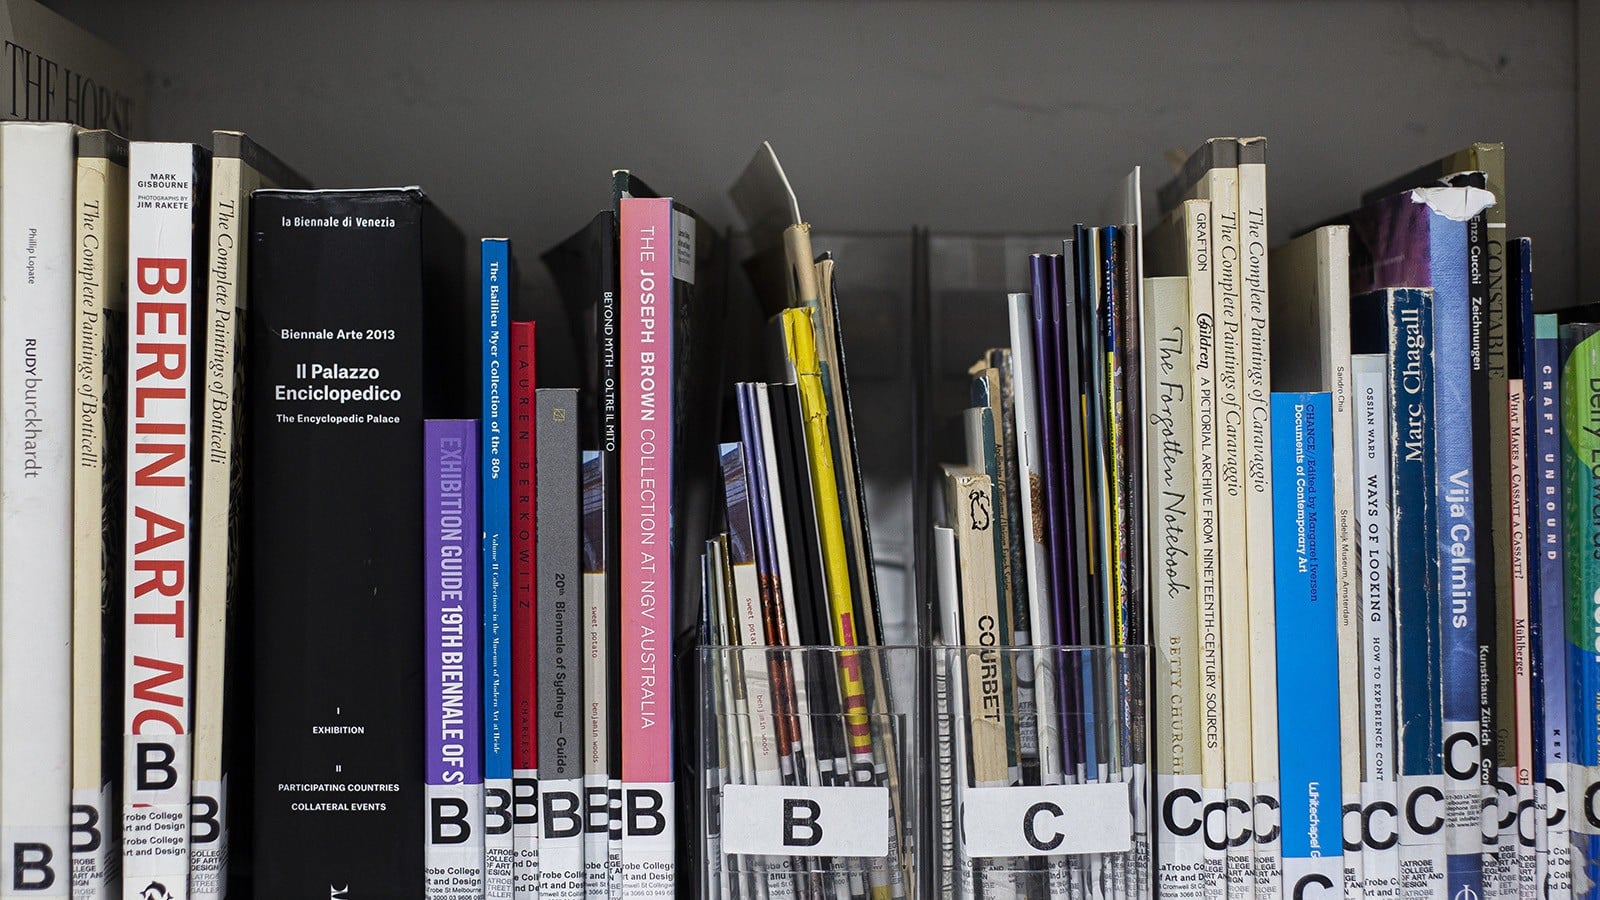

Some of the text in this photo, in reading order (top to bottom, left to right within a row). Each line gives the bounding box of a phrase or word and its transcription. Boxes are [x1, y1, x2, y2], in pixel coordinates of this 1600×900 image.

[282, 216, 394, 227] la Biennale di Venezia
[1197, 213, 1207, 271] GRAFTON
[26, 228, 36, 284] Phillip Lopate
[490, 285, 499, 326] Baillieu
[1470, 215, 1482, 370] Enzo Cucchi Zeichnungen
[1488, 240, 1504, 378] CONSTABLE
[78, 201, 99, 468] The Complete Paintings of Botticelli
[209, 200, 235, 462] The Complete Paintings of Botticelli
[281, 329, 395, 340] Biennale Arte 2013
[489, 331, 498, 356] Myer
[1197, 312, 1213, 370] Children
[1217, 212, 1241, 496] The Complete Paintings of Caravaggio
[1245, 208, 1267, 491] The Complete Paintings Caravaggio
[276, 385, 401, 403] Enciclopedico
[297, 364, 379, 379] Il Palazzo
[491, 360, 500, 417] Collection
[604, 292, 614, 451] BEYOND MYTH OLTRE IL MITO
[1402, 308, 1424, 462] Marc Chagall
[276, 414, 400, 424] The Encyclopedic Palace
[491, 421, 499, 433] of
[1295, 404, 1304, 463] Documents
[133, 258, 186, 636] BERLIN ART
[491, 458, 500, 478] 80s
[1150, 327, 1190, 599] The Forgotten Notebook
[1543, 365, 1556, 559] CRAFT UNBOUND
[520, 344, 529, 608] LAUREN BERKOWITZ
[640, 226, 655, 728] THE JOSEPH BROWN COLLECTION AT NGV AUSTRALIA
[1295, 478, 1306, 554] Contemporary
[1307, 512, 1317, 560] Margaret
[1201, 389, 1217, 748] PICTORIAL ARCHIVE FROM NINETEENTH-CENTURY SOURCES
[1367, 474, 1380, 622] WAYS OF LOOKING
[1445, 469, 1471, 628] Vija Celmins
[440, 440, 464, 768] EXHIBITION GUIDE 19TH BIENNALE OF
[978, 615, 1000, 722] COURBET
[1170, 637, 1181, 688] BETTY
[1374, 666, 1380, 679] TO
[1515, 619, 1524, 676] Mühlberger
[553, 602, 567, 773] Biennale of Sydney Guide
[1480, 645, 1491, 745] Kunsthaus Zürich
[1374, 683, 1382, 748] EXPERIENCE
[137, 742, 178, 791] B
[1444, 732, 1479, 780] C
[149, 812, 182, 820] College
[154, 822, 185, 831] Design
[431, 798, 471, 844] B
[485, 788, 512, 834] B
[542, 791, 582, 839] B
[627, 789, 666, 836] B
[783, 798, 823, 847] B
[1023, 802, 1065, 851] C
[1163, 788, 1202, 836] C
[1308, 782, 1320, 848] Whitechapel
[1361, 802, 1398, 850] C
[1406, 786, 1444, 835] C
[13, 843, 56, 890] B
[155, 847, 188, 856] Design
[447, 867, 480, 876] College
[452, 877, 481, 886] Design
